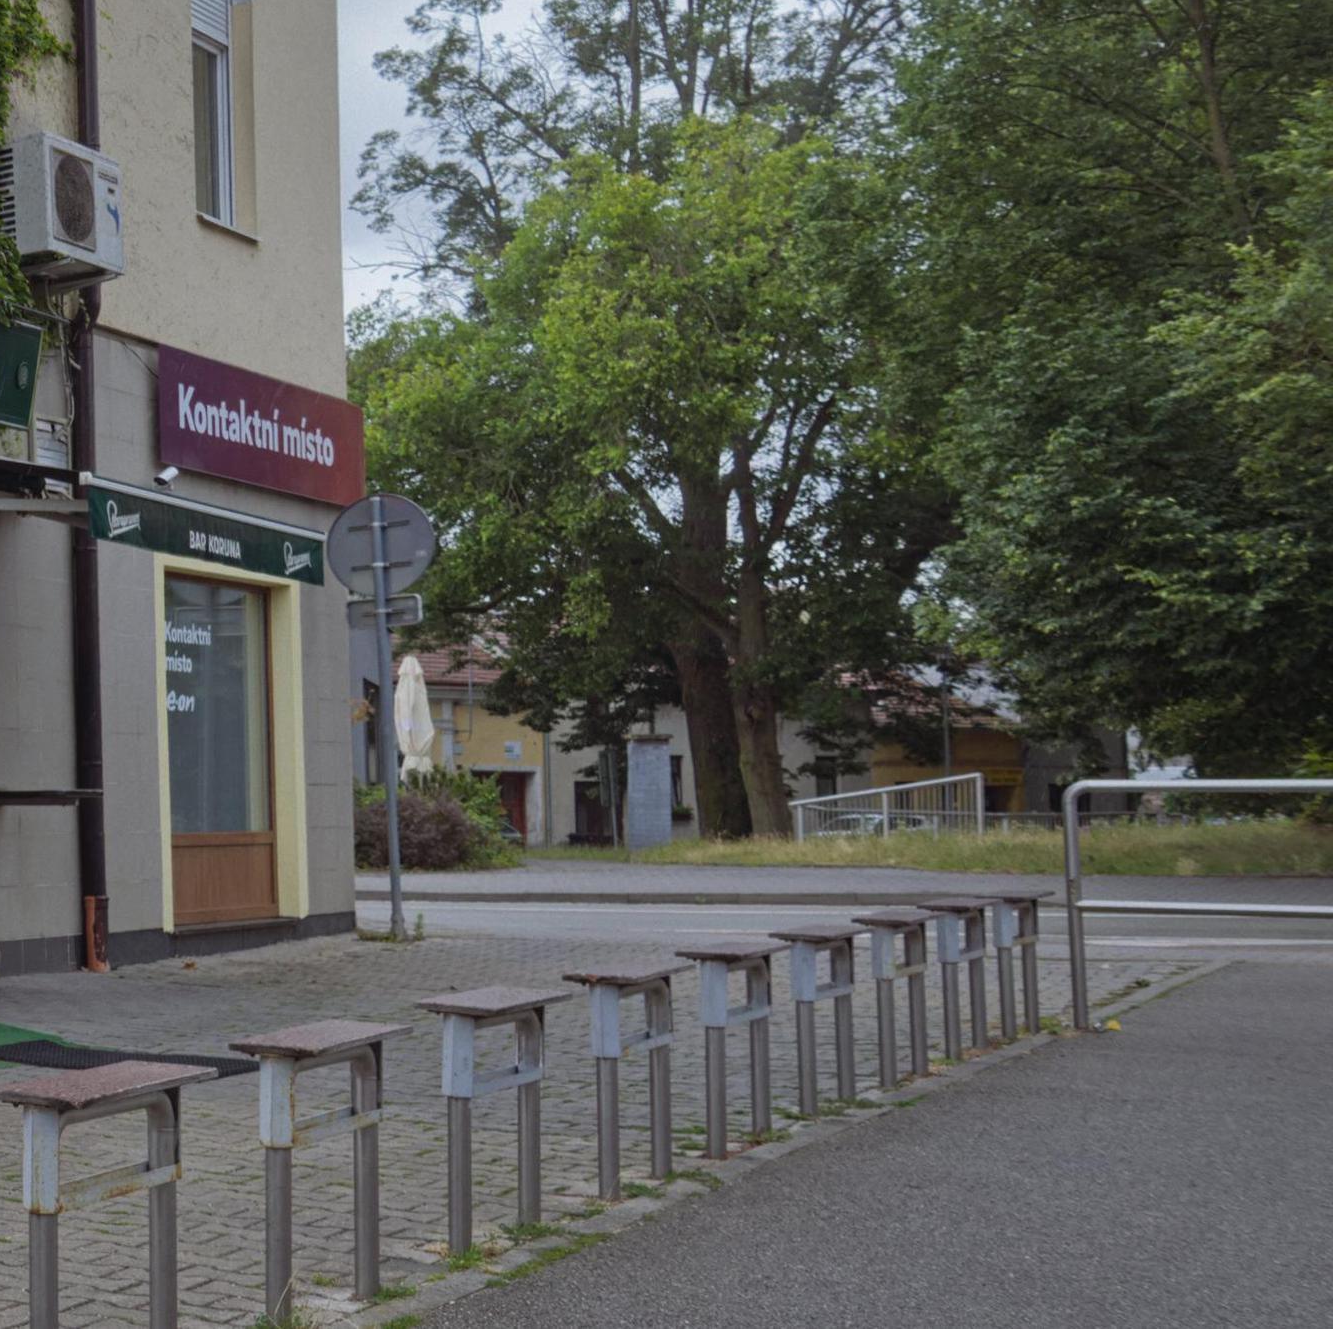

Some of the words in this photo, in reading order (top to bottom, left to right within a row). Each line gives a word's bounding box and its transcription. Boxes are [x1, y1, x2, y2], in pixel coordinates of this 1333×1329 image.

[178, 383, 280, 453] Kontaktní
[283, 417, 334, 467] místo
[189, 530, 206, 551] BAR
[208, 534, 241, 560] KORUNA
[165, 621, 211, 646] Kontaktní
[166, 650, 193, 673] místo
